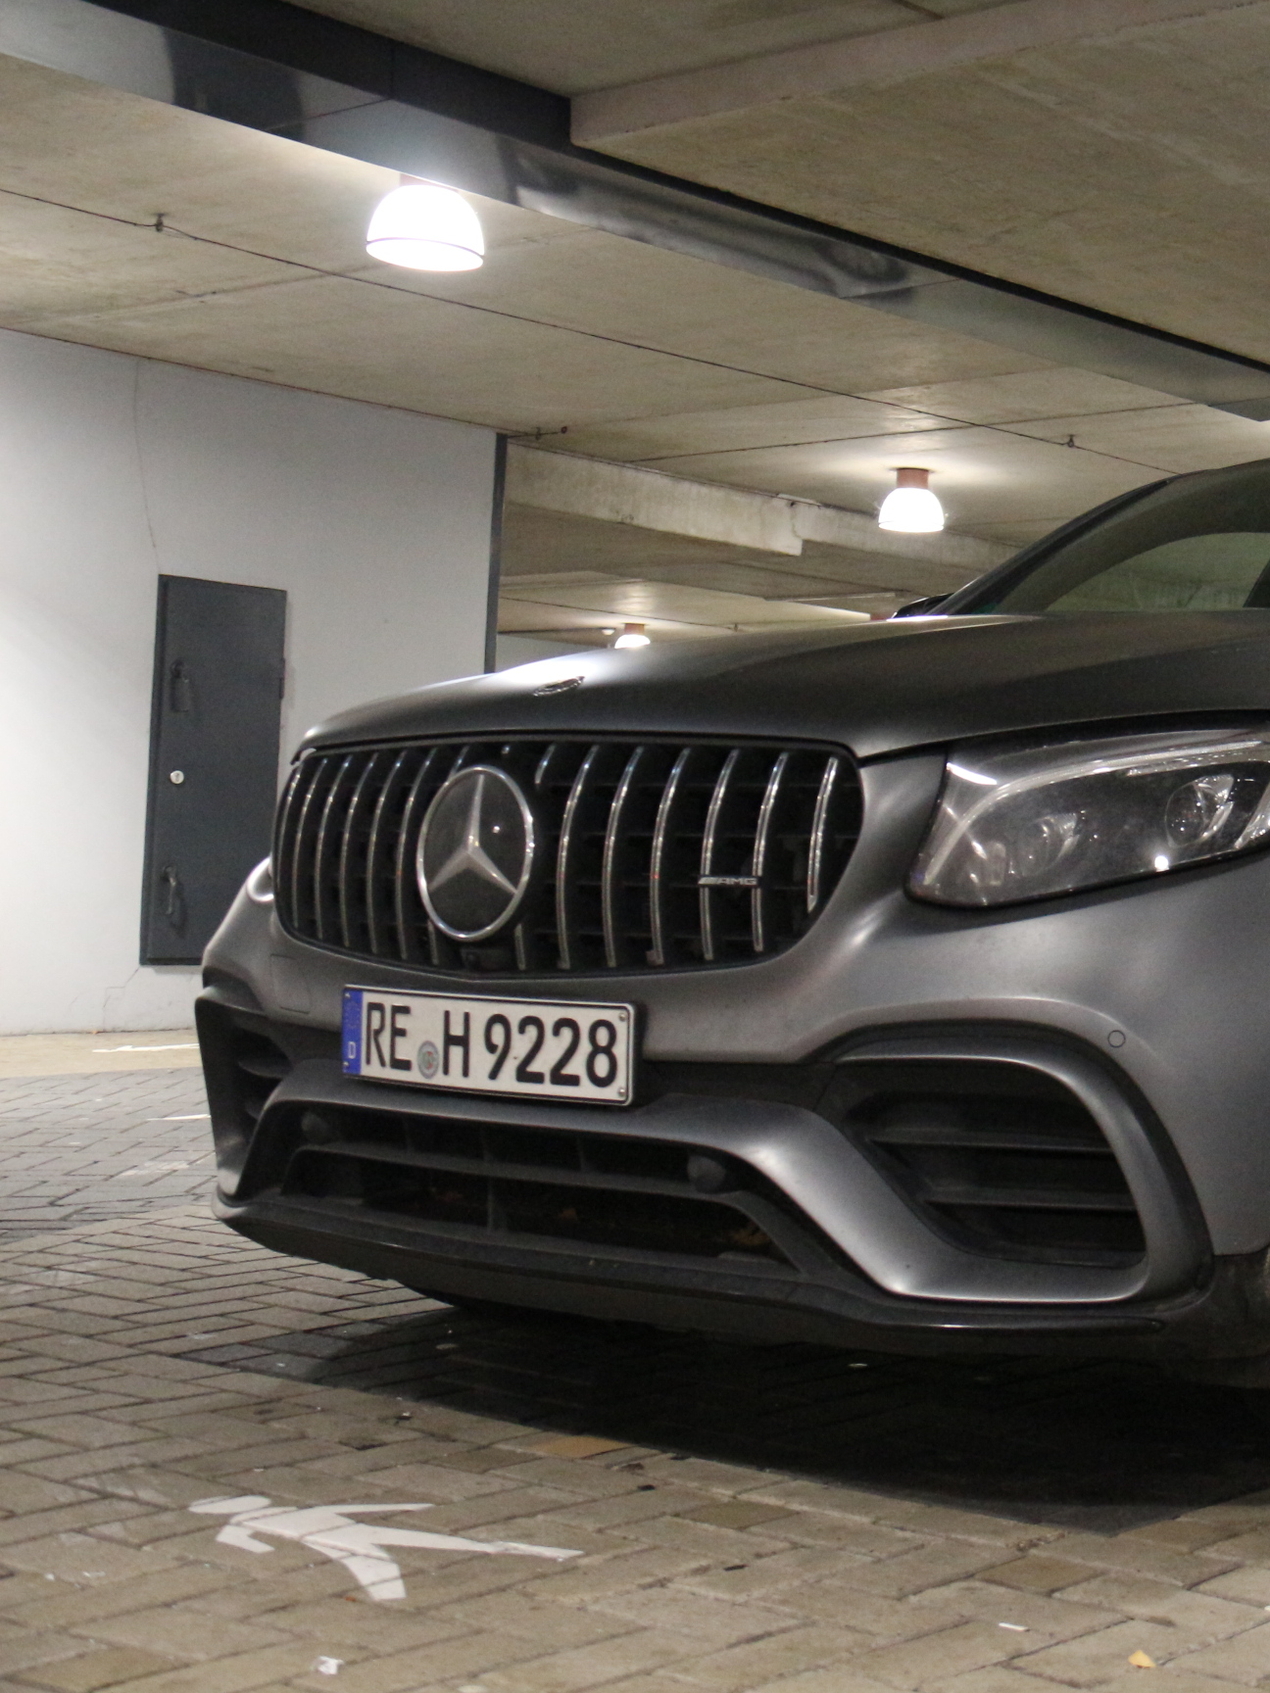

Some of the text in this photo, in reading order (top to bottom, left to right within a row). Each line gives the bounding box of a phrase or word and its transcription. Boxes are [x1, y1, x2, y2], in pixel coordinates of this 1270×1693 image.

[348, 1041, 356, 1059] D
[366, 1002, 617, 1088] RE H 9228
